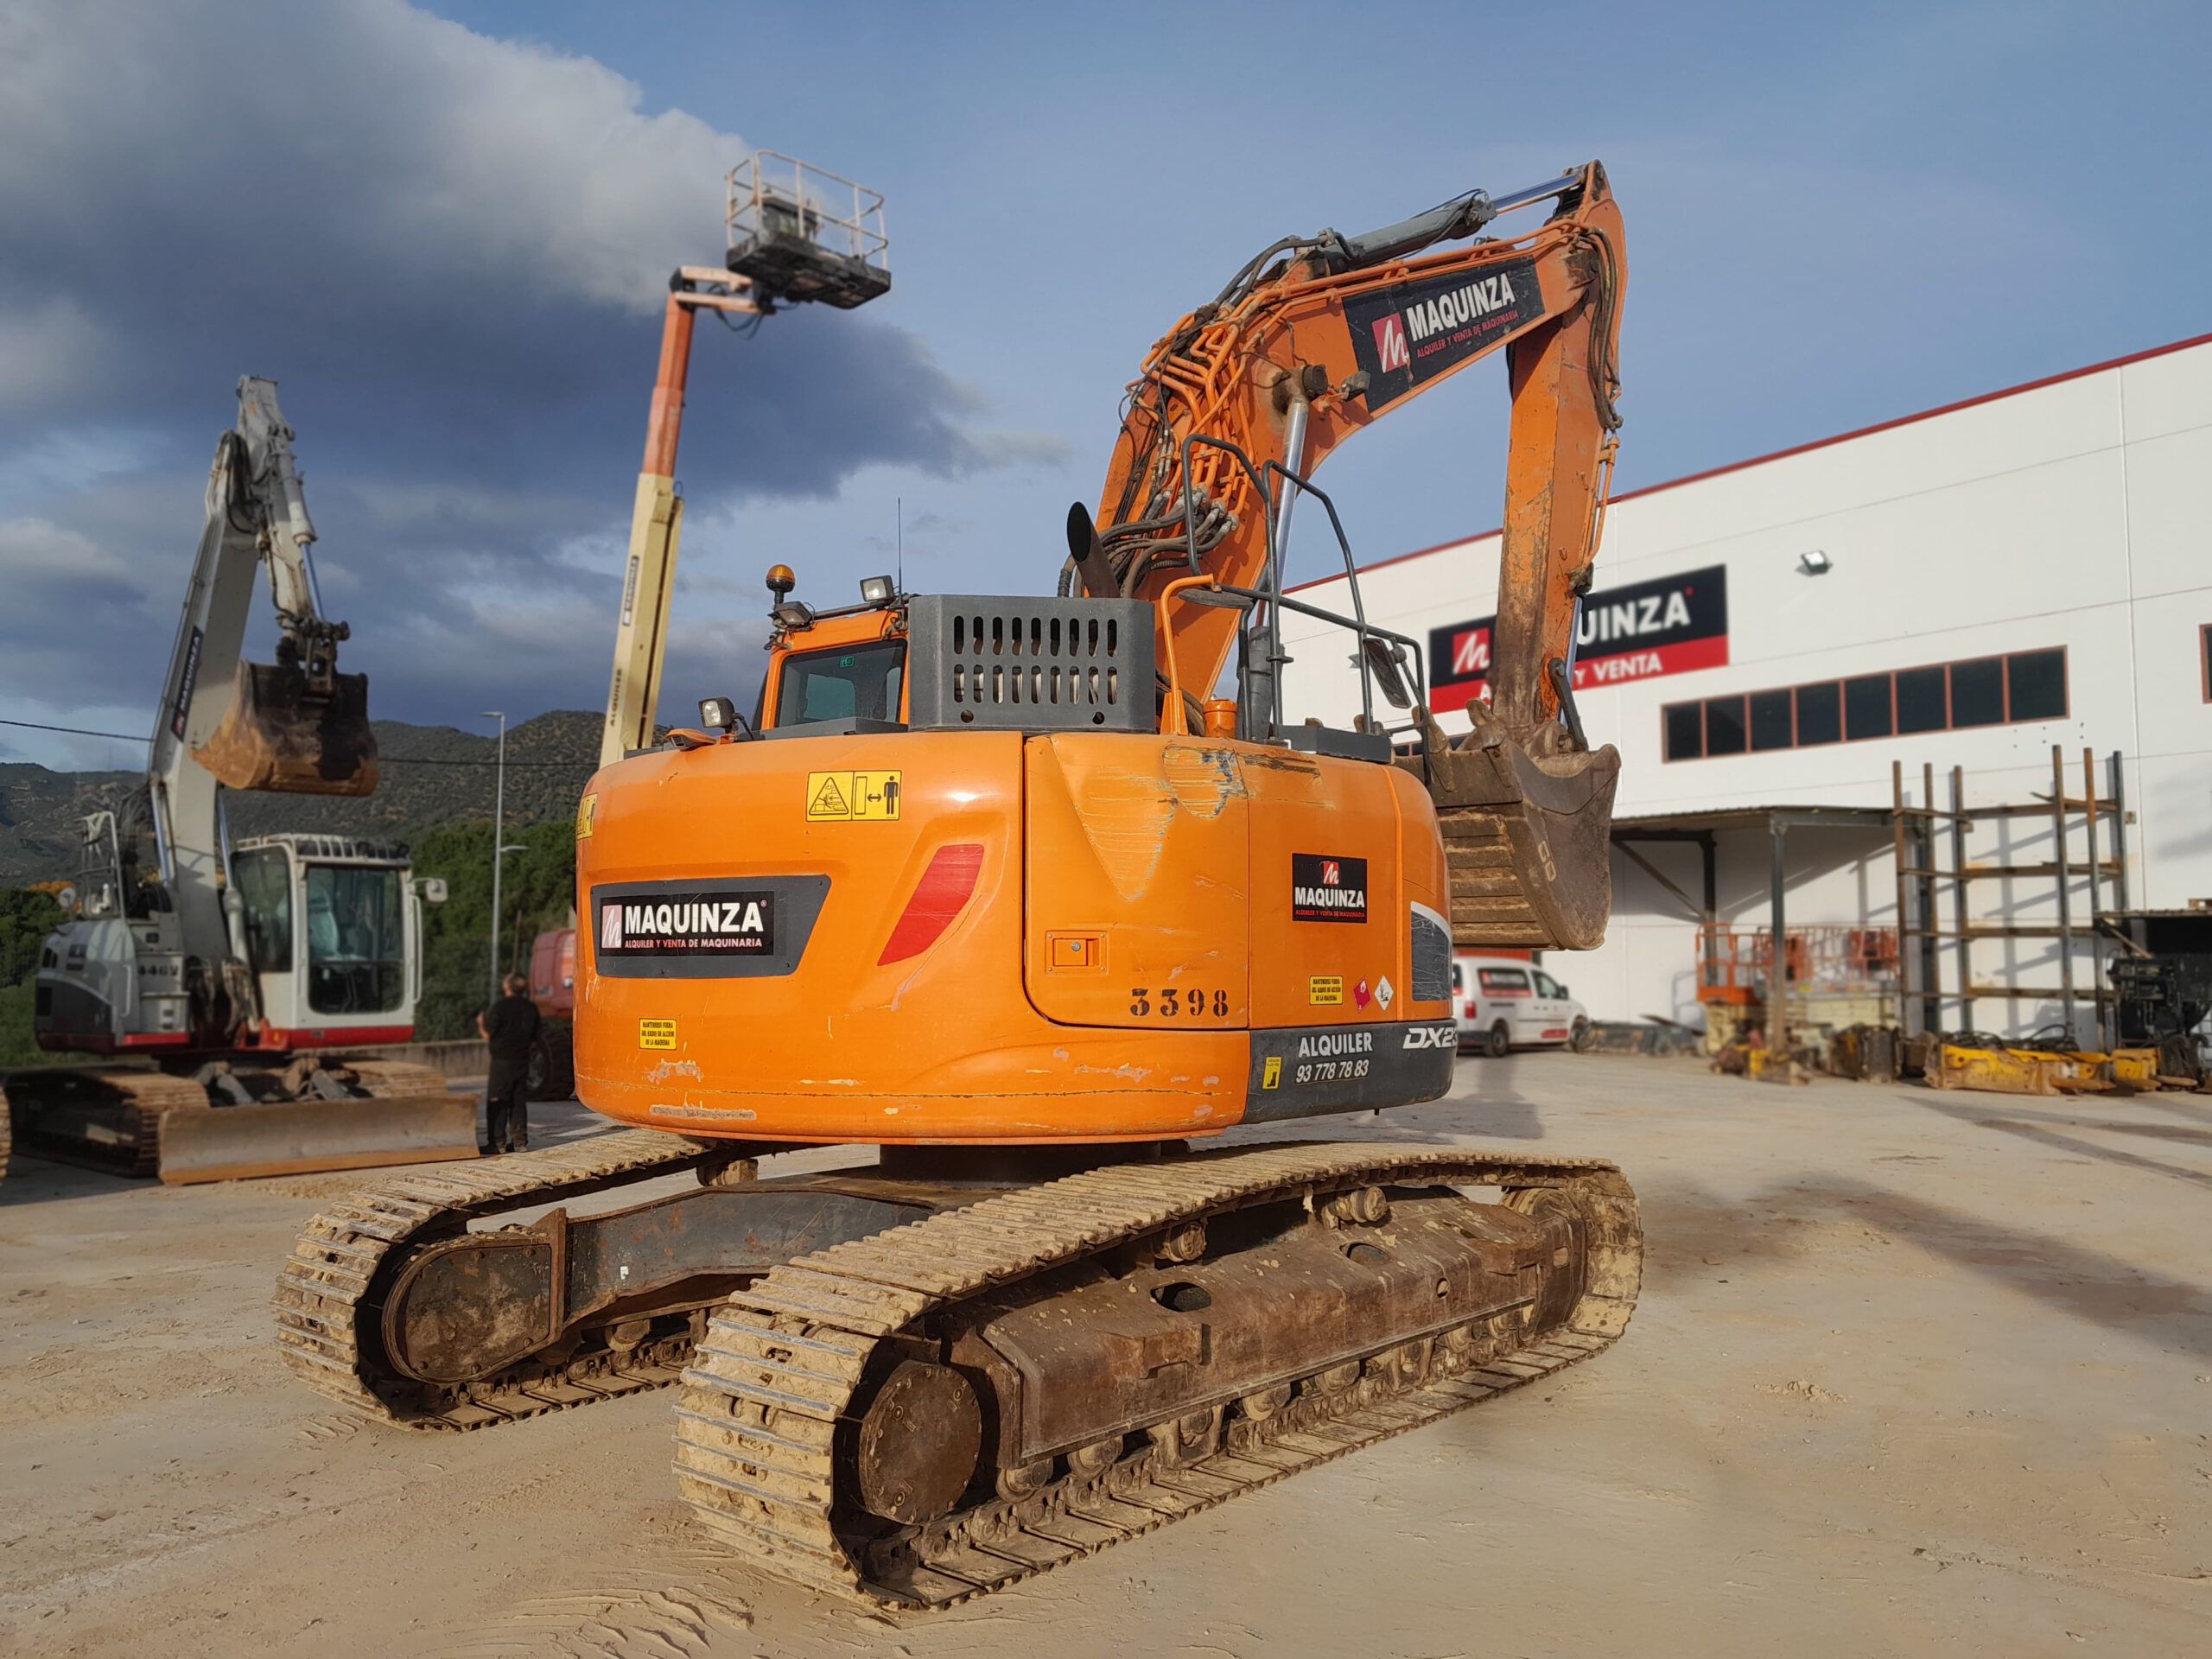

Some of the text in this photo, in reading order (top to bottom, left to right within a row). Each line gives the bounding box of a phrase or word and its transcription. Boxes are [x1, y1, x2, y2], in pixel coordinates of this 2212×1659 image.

[1406, 273, 1516, 341] MAQUINZA
[1417, 339, 1446, 359] ALQUILER
[1452, 330, 1473, 343] VENTA
[1473, 327, 1482, 335] DE
[1577, 591, 1690, 645] UINZA
[1592, 652, 1662, 681] VENTA
[1295, 887, 1365, 908] MAQUINZA
[625, 938, 762, 949] ALQUILER Y VENTA DE MAQUINARIA
[1130, 988, 1229, 1017] 3398
[1299, 1032, 1373, 1058] ALQUILER
[1296, 1059, 1370, 1083] 93 778 78 83
